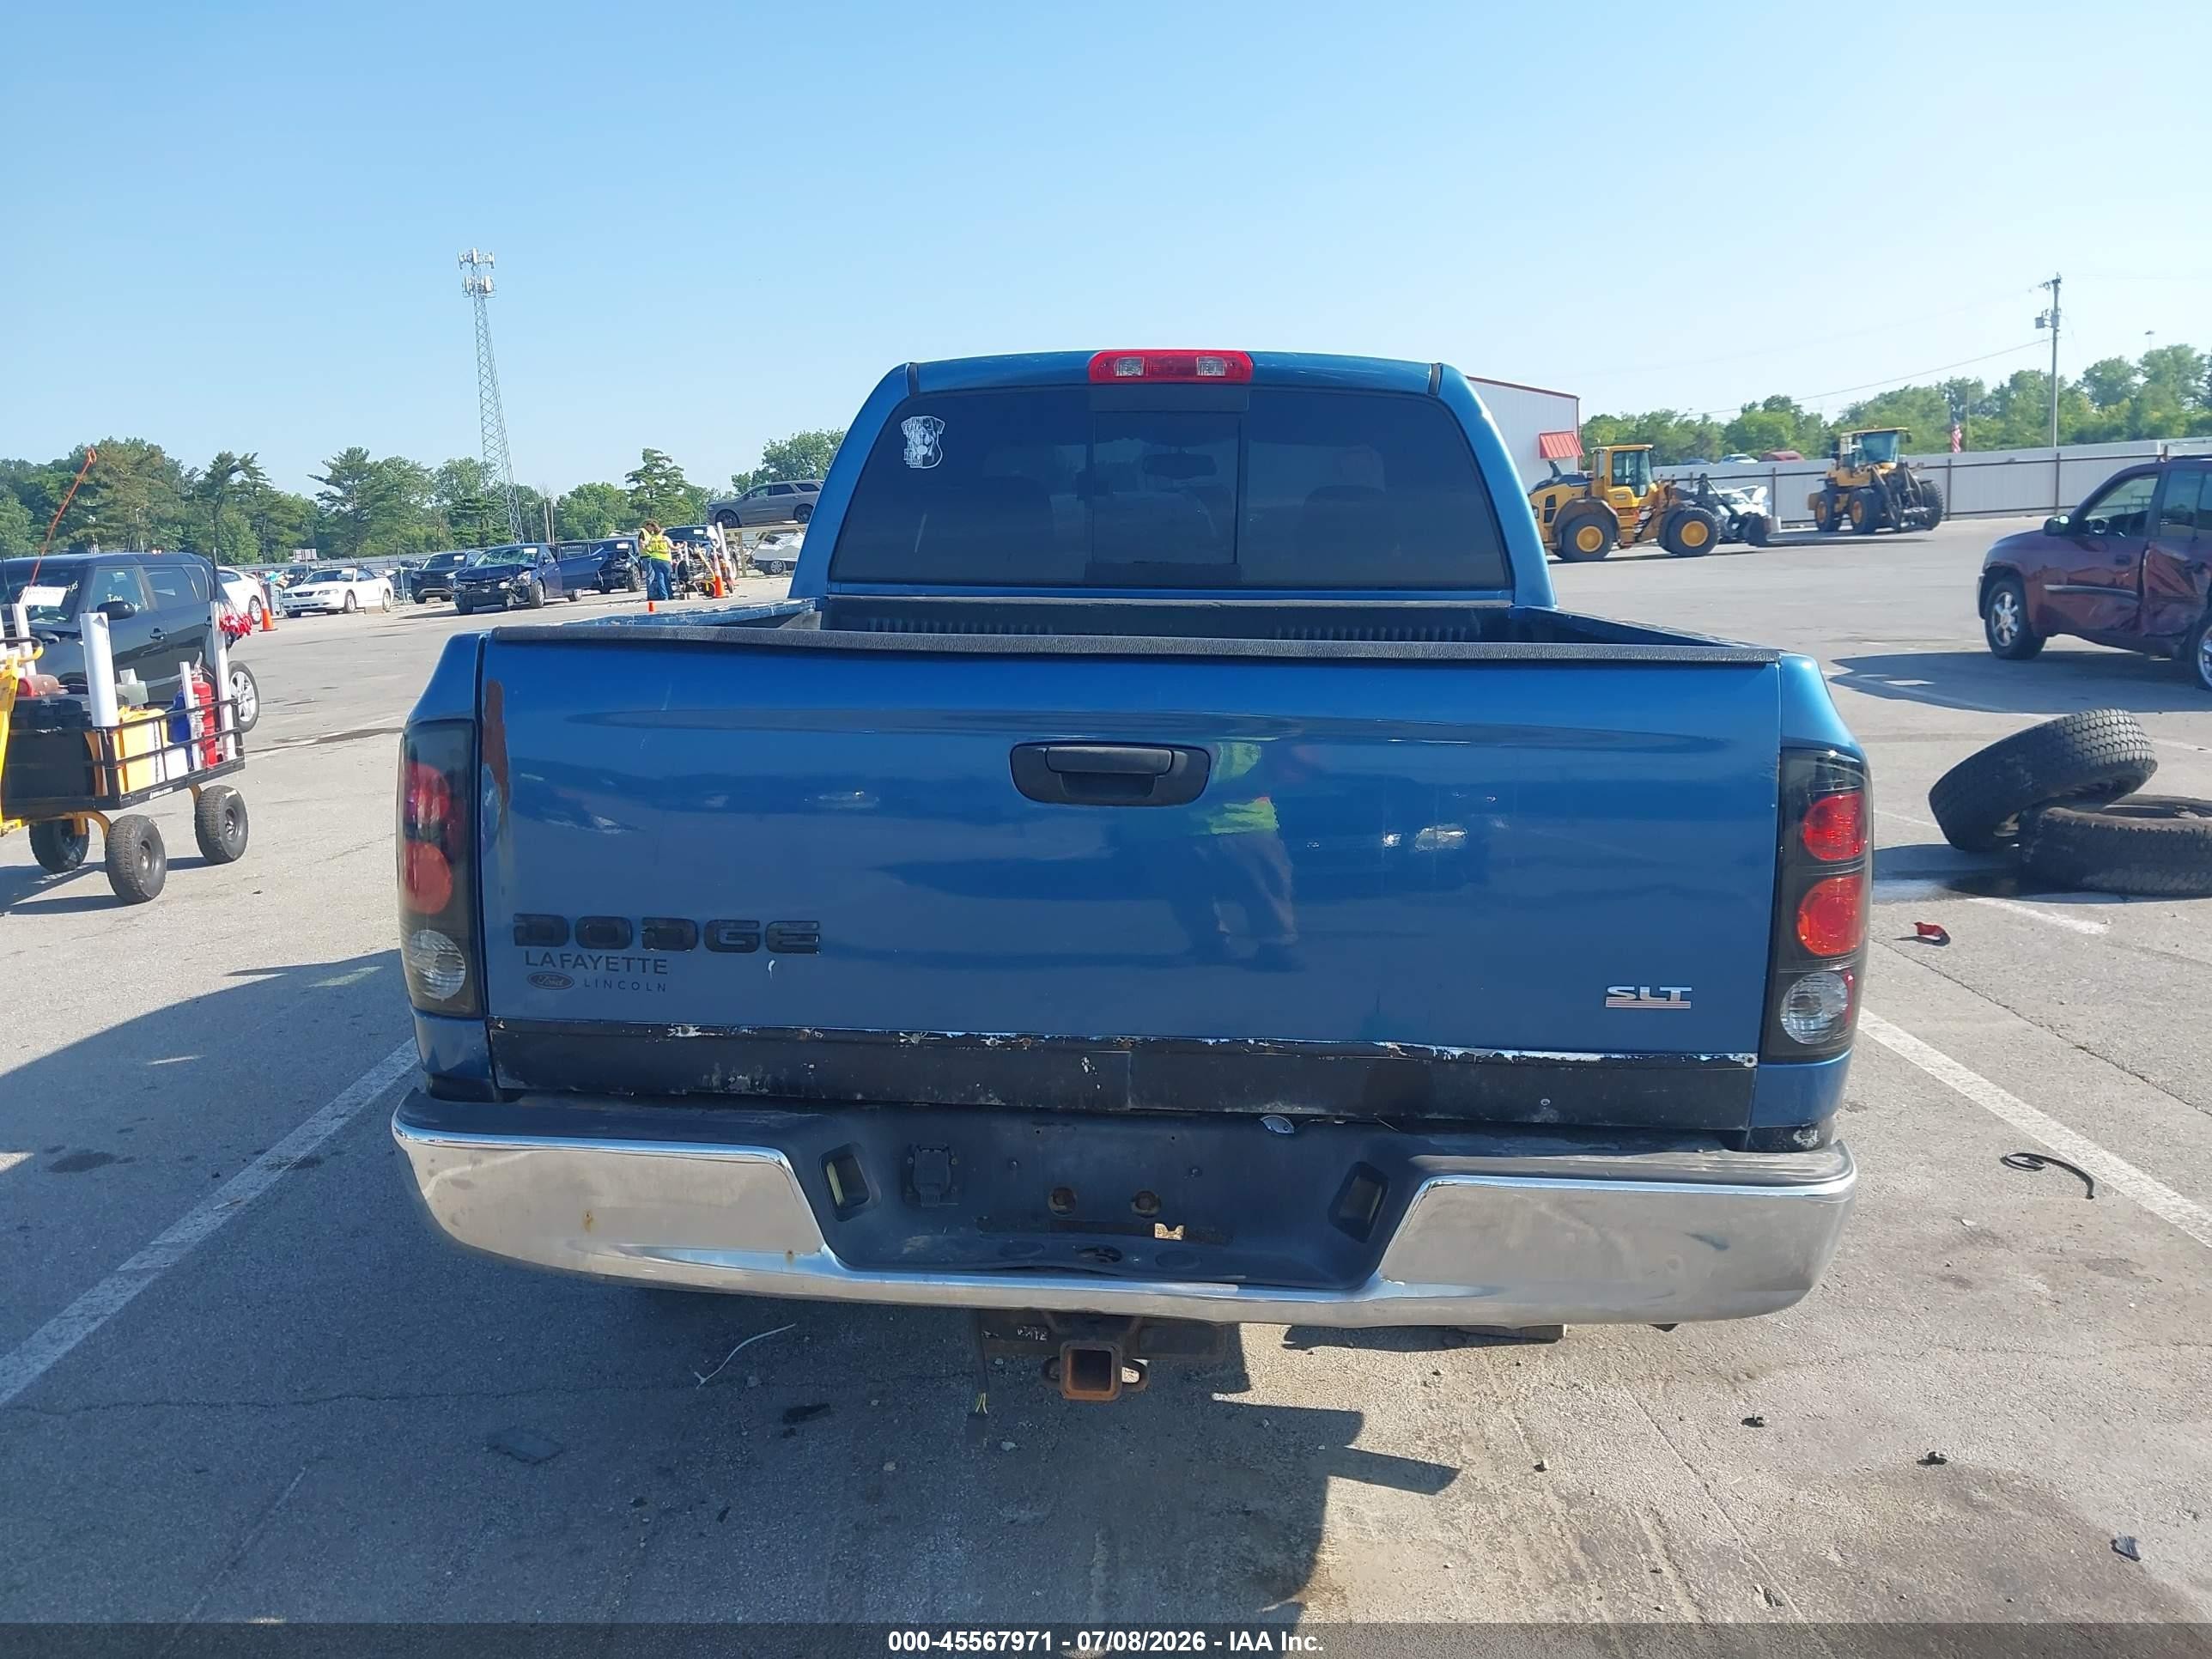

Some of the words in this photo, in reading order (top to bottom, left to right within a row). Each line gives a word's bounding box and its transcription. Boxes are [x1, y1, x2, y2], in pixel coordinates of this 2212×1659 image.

[513, 914, 820, 954] DODGE
[525, 950, 668, 975] LAFAYETTE
[584, 978, 666, 993] LINCOLN
[1607, 985, 1692, 1002] SLT
